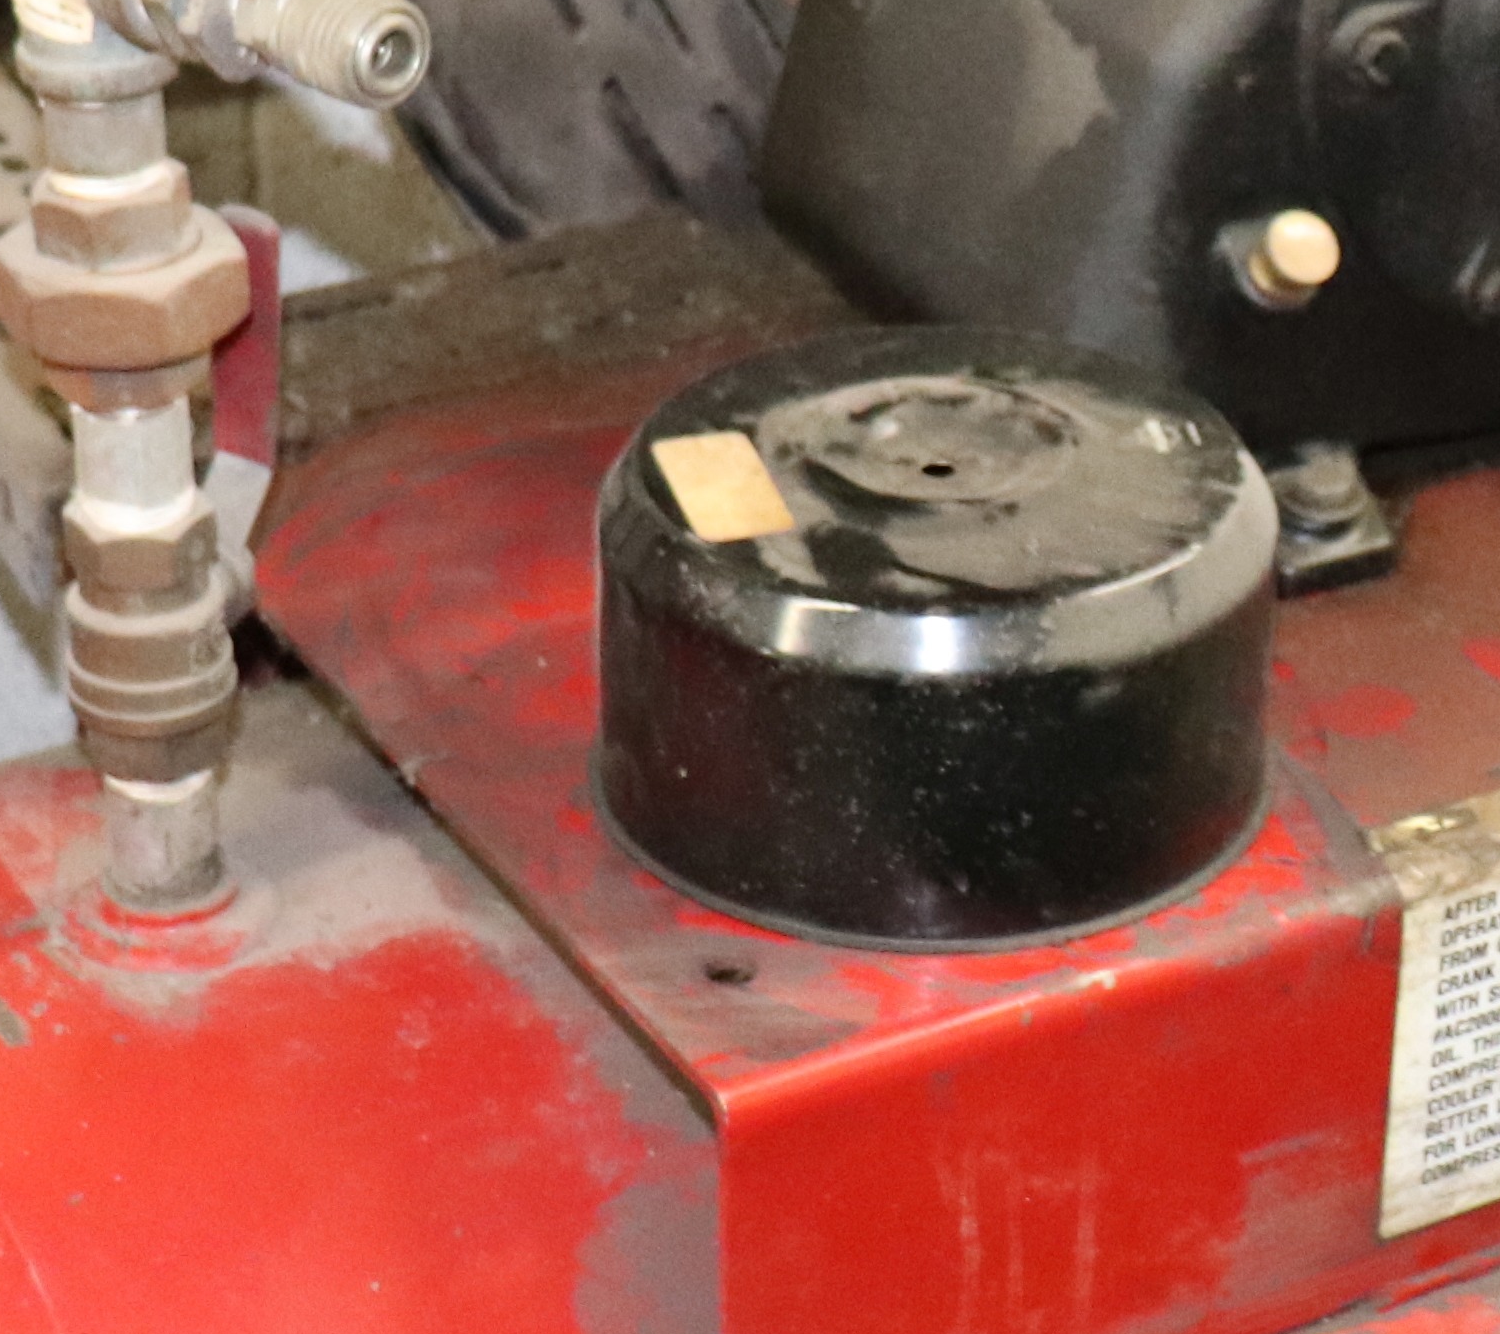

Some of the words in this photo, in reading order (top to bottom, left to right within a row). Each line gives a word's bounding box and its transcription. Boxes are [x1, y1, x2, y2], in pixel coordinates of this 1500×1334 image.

[1443, 890, 1497, 921] AFTER
[1439, 941, 1489, 971] FROM
[1437, 963, 1494, 995] CRANK
[1435, 991, 1479, 1019] WITH
[1426, 1078, 1494, 1114] COOLER
[1424, 1104, 1488, 1137] BETTER
[1423, 1136, 1455, 1160] FOR
